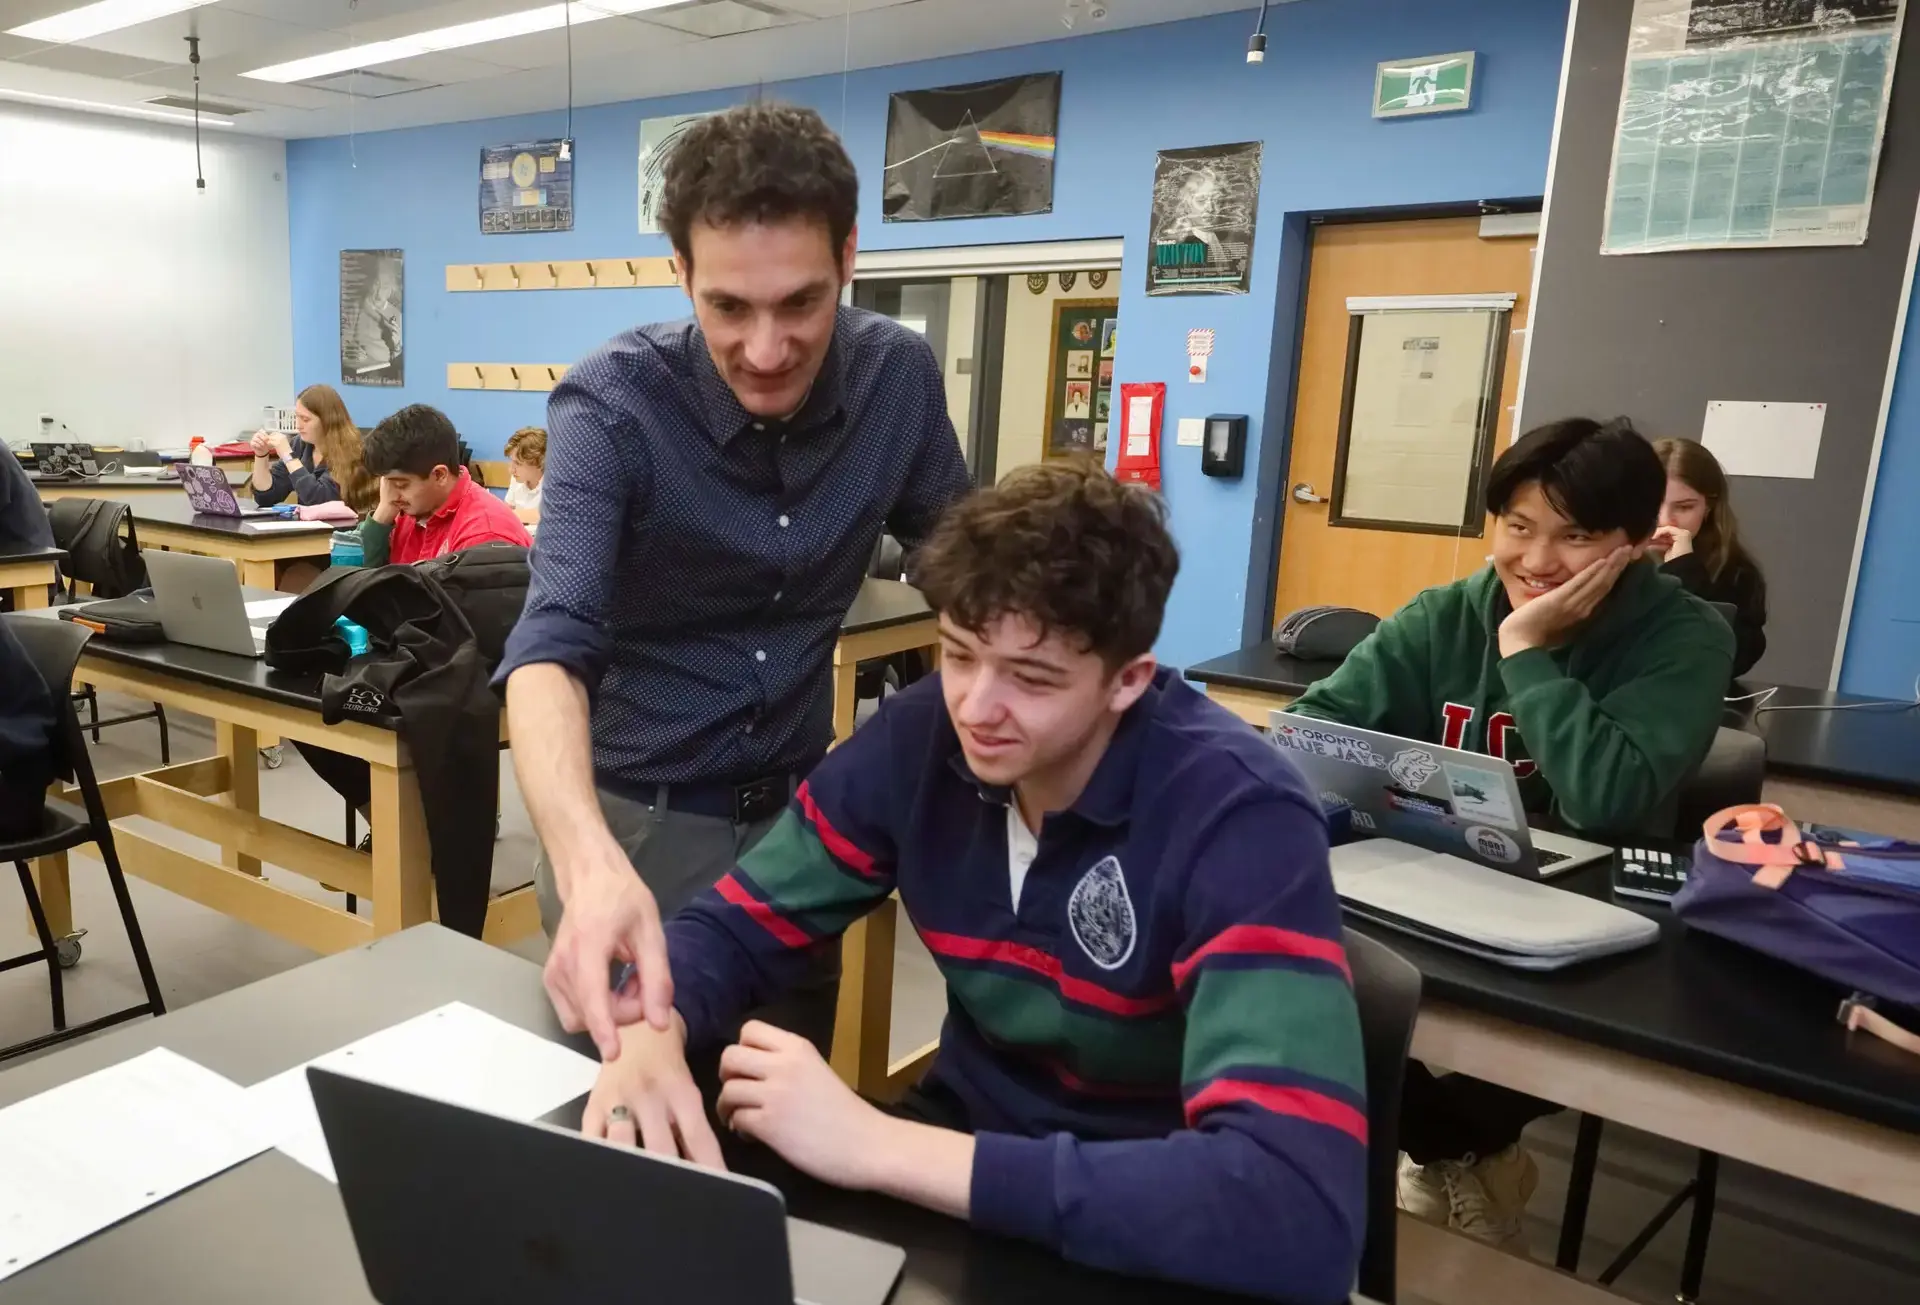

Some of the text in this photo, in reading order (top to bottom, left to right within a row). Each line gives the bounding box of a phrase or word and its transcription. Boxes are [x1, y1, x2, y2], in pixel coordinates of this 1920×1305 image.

[1275, 733, 1387, 770] BLUE JAYS
[1293, 726, 1371, 751] TORONTO
